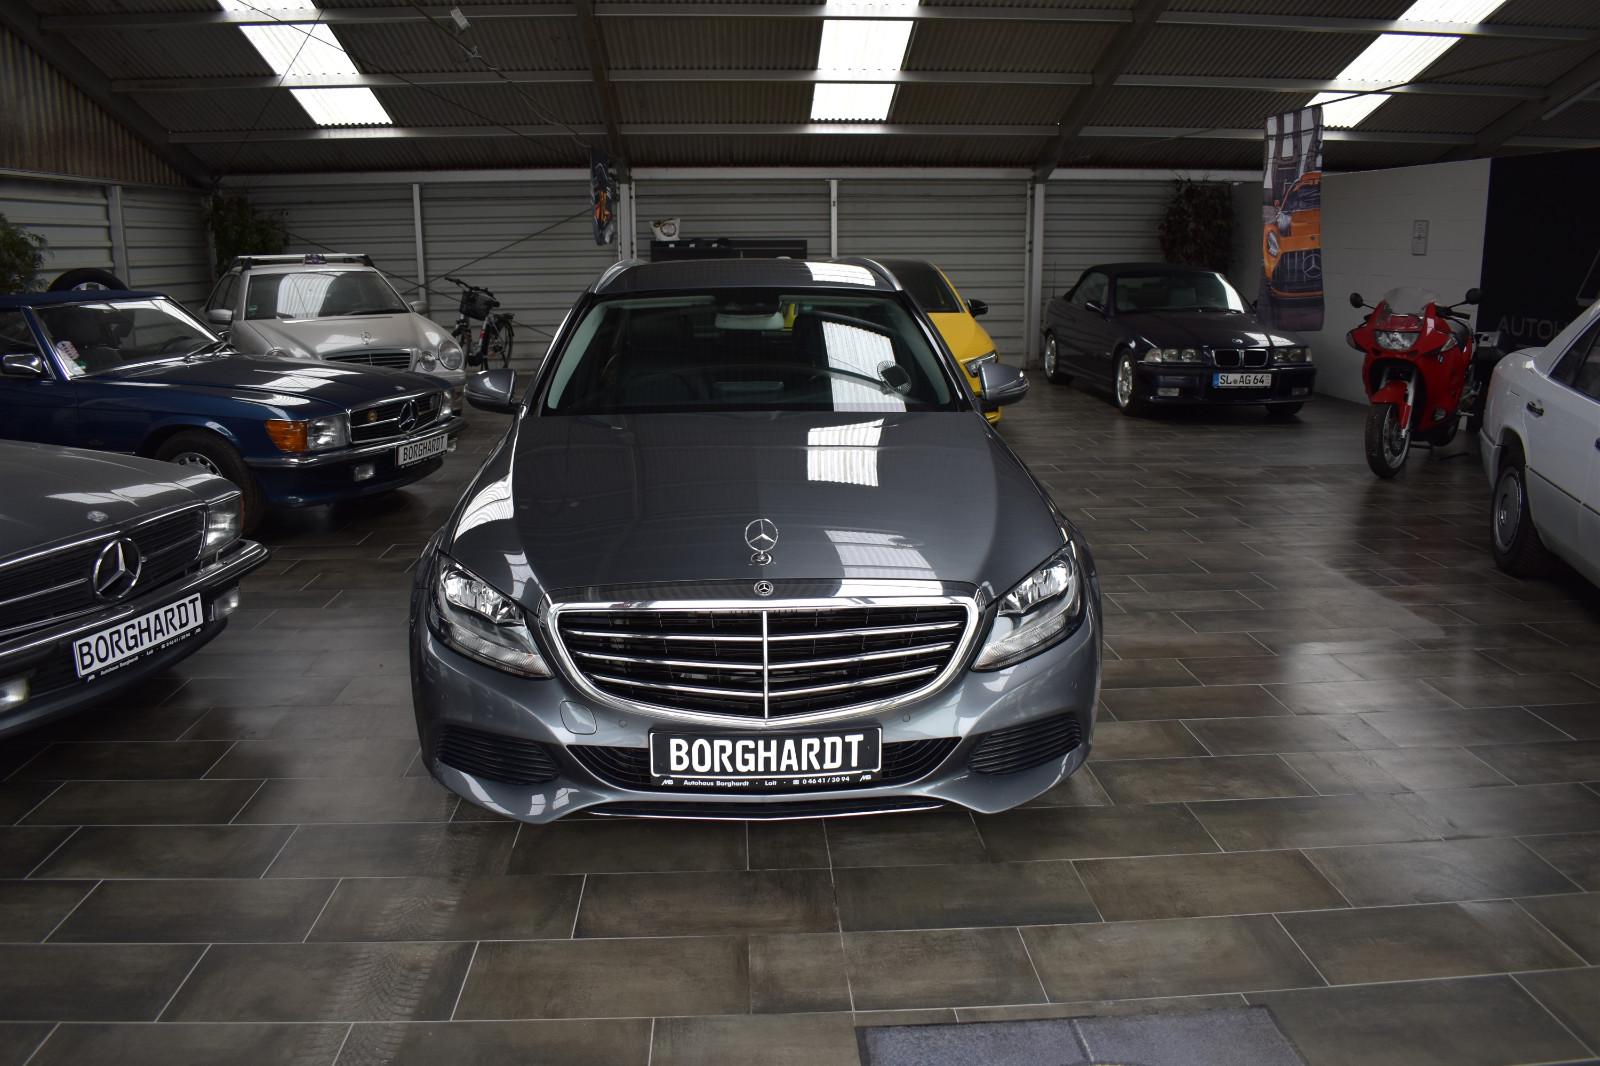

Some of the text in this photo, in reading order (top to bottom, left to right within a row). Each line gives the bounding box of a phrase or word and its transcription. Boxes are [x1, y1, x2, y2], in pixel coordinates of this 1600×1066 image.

[1219, 374, 1232, 385] SL
[1238, 374, 1251, 385] AG
[1252, 374, 1265, 385] 64
[403, 435, 445, 461] BORGHARDT
[78, 596, 200, 670] BORGHARDT
[669, 734, 864, 773] BORGHARDT
